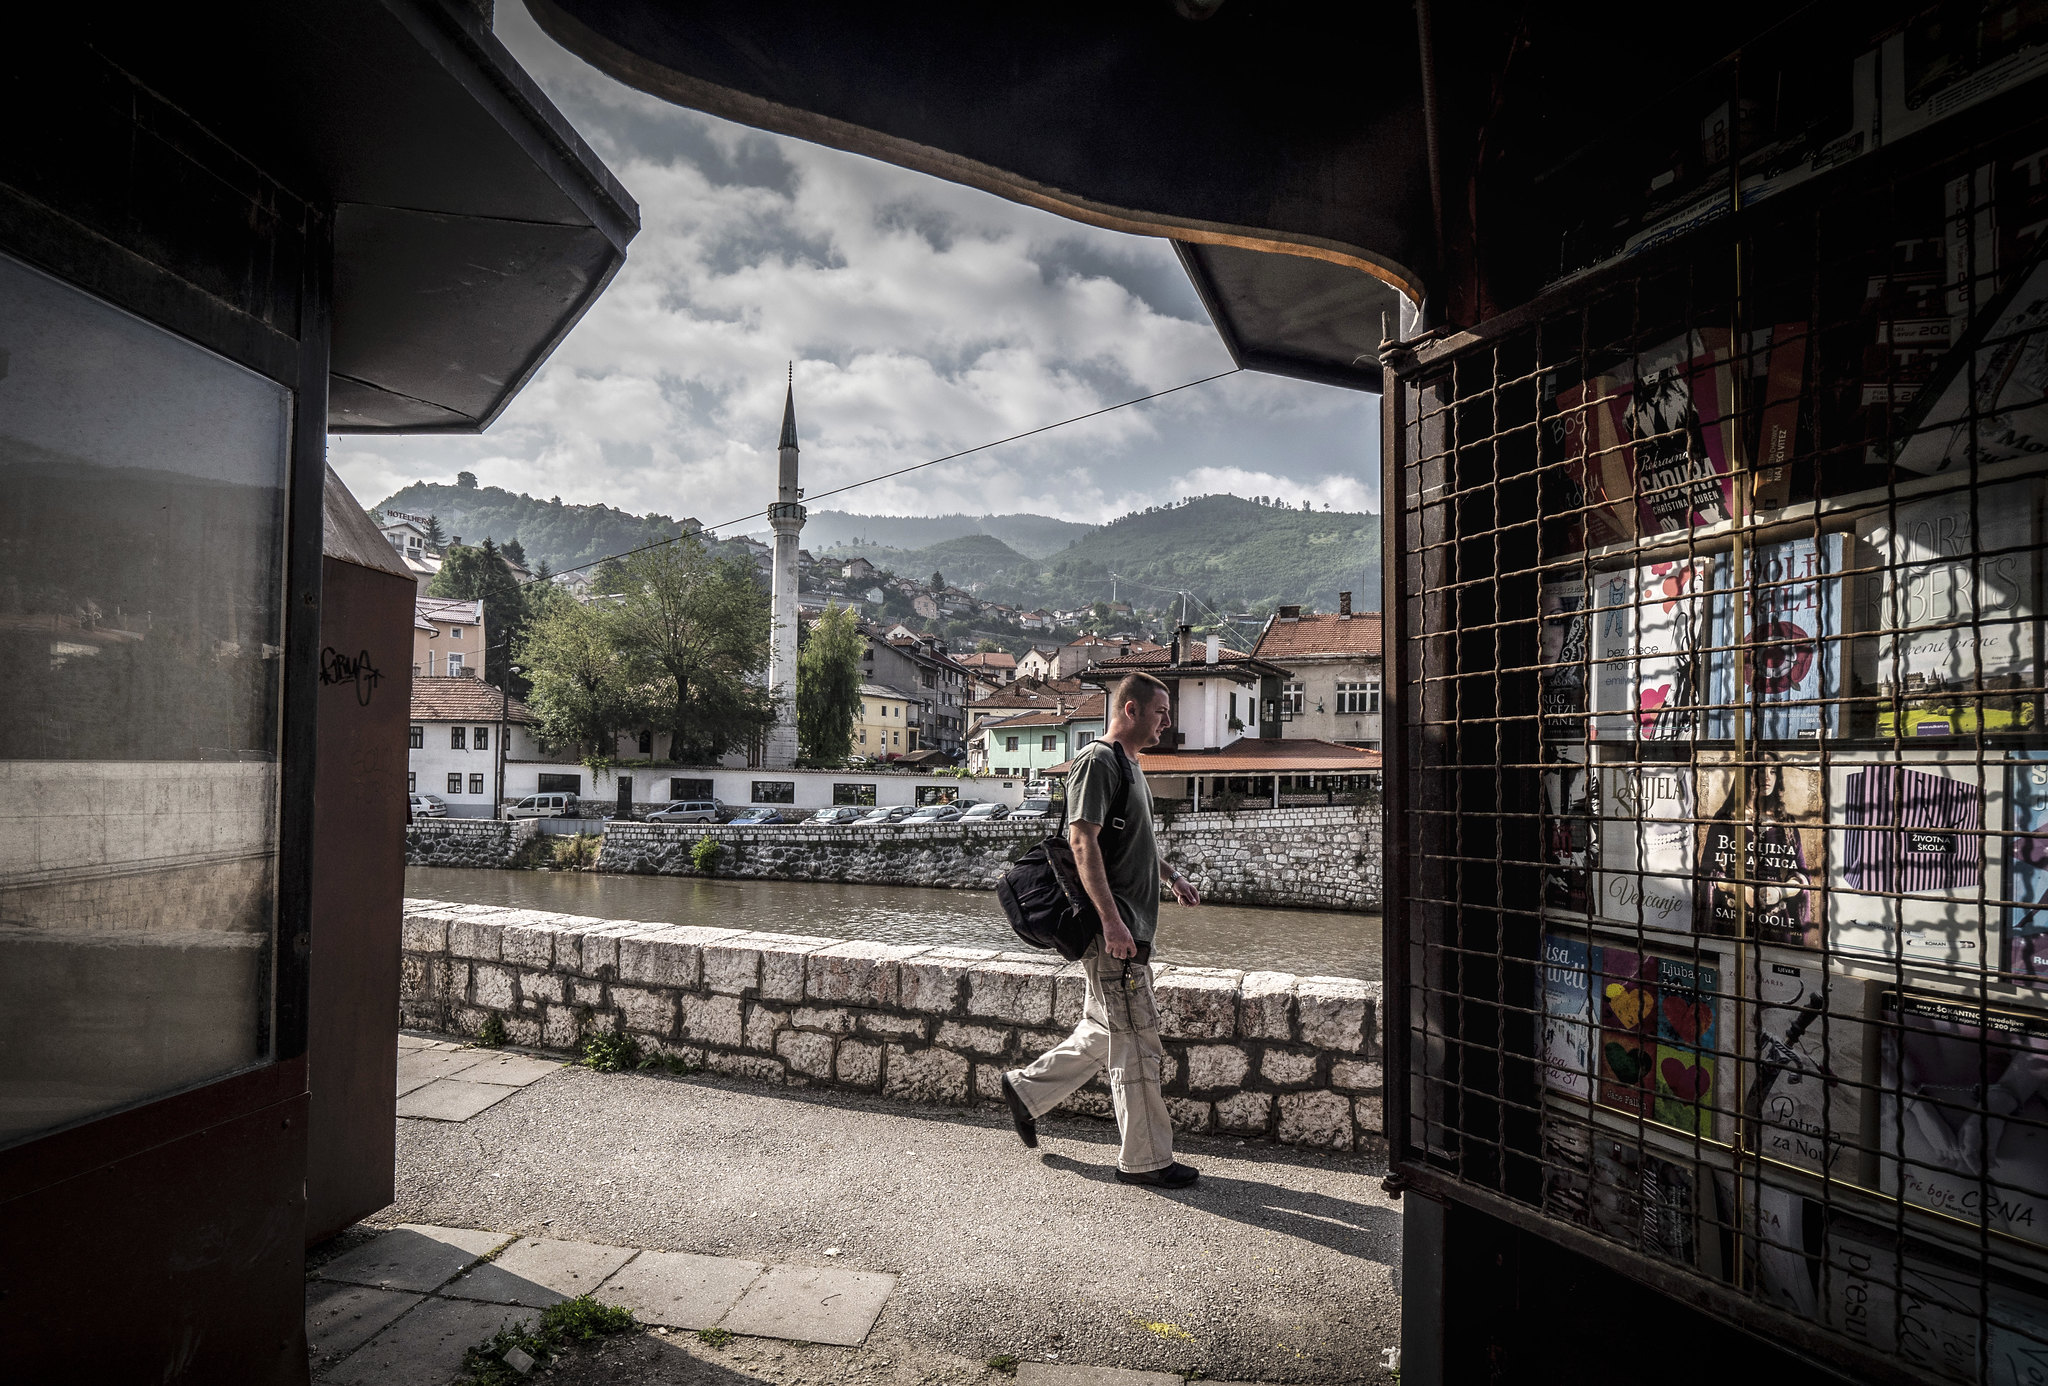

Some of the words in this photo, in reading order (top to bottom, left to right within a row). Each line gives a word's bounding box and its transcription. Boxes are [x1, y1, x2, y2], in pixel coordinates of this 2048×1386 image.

[1652, 498, 1689, 515] CHRISTINA
[1692, 490, 1720, 505] AUREN
[387, 509, 411, 522] HOTEL
[1863, 556, 2022, 633] ROBERTS
[1606, 648, 1625, 657] bez
[1627, 645, 1661, 657] dece,
[1541, 693, 1565, 705] RUG
[1717, 834, 1797, 856] BOGIJINA
[1912, 833, 1951, 844] ŽIVOTNA
[1917, 842, 1947, 852] ŠKOLA
[1714, 852, 1799, 870] LJUANICA
[1715, 907, 1741, 921] SAR
[1751, 911, 1795, 929] OOLE
[1545, 943, 1570, 965] isa
[1662, 961, 1702, 980] Ljuba
[1704, 973, 1712, 984] u
[1746, 975, 1784, 987] FEARIS
[1915, 1004, 1931, 1013] sexy
[1994, 1023, 2009, 1031] 200
[1624, 1094, 1647, 1110] Falln
[1773, 1135, 1790, 1150] za
[1927, 1183, 1955, 1207] boje
[1961, 1190, 2036, 1227] CRNA
